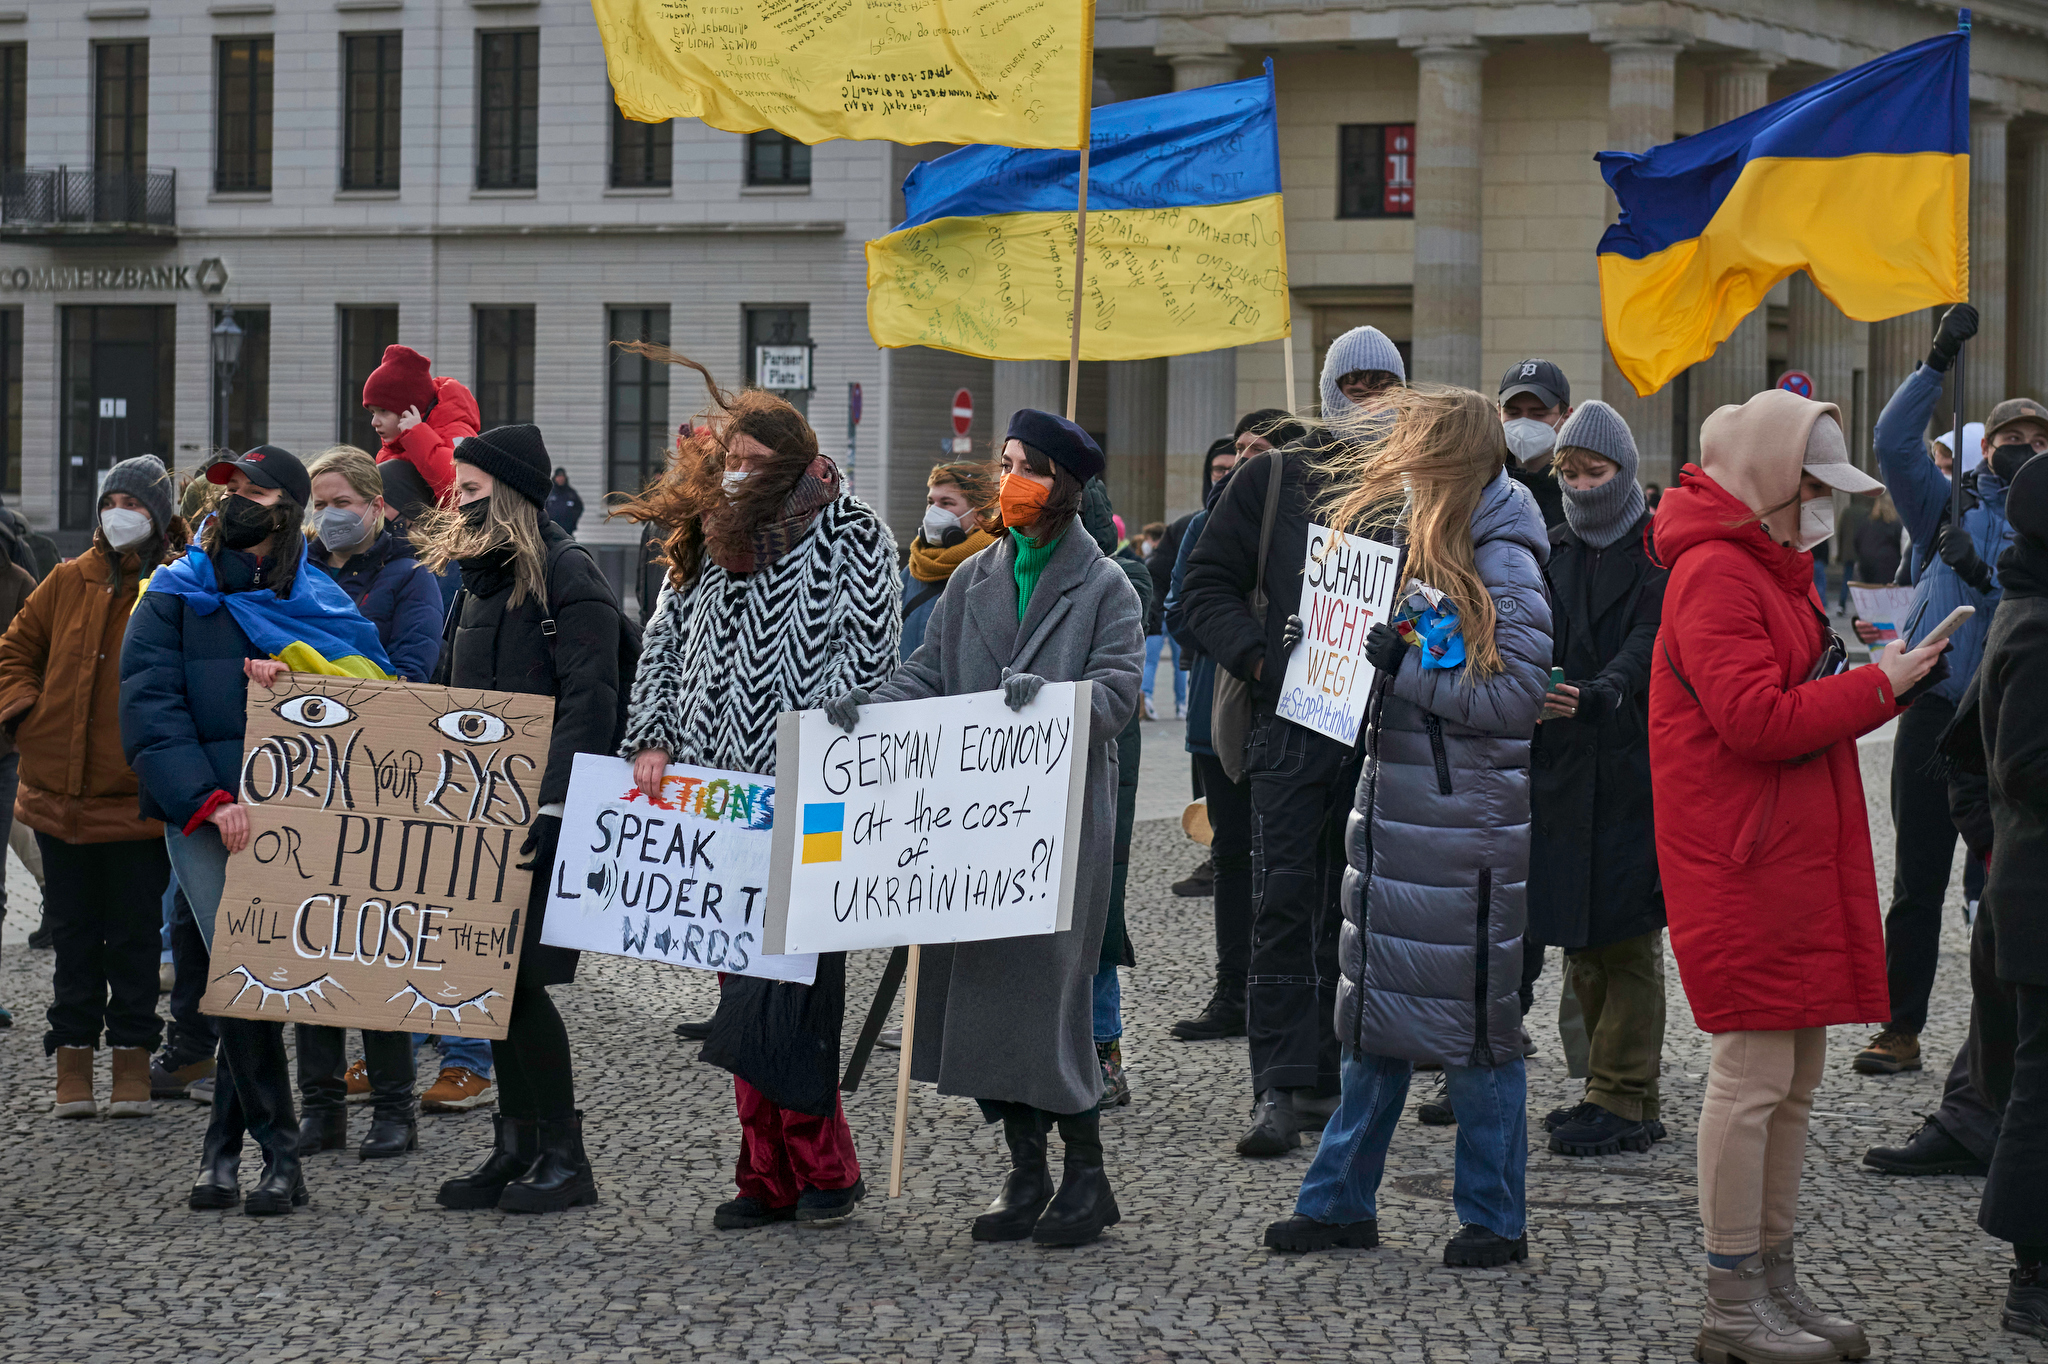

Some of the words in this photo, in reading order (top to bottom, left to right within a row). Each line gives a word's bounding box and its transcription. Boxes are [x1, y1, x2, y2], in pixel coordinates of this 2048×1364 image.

[0, 266, 192, 291] COMMERZBANK
[762, 351, 803, 366] Pariser
[769, 369, 796, 384] Platz
[1308, 536, 1394, 607] SCHAUT
[1307, 592, 1374, 656] NICHT
[1307, 646, 1359, 701] WEG!
[240, 728, 364, 812] OPEN
[363, 744, 424, 814] YOUR
[424, 748, 537, 826] EYES
[822, 724, 942, 795] GERMAN
[960, 717, 1071, 775] ECONOMY
[590, 809, 717, 871] SPEAK
[853, 800, 893, 845] at
[904, 788, 952, 834] the
[962, 785, 1032, 831] cost
[253, 825, 314, 879] OR
[329, 814, 514, 903] PUTIN
[897, 837, 929, 868] of
[293, 892, 455, 971] CLOSE
[449, 908, 521, 970] THEM!
